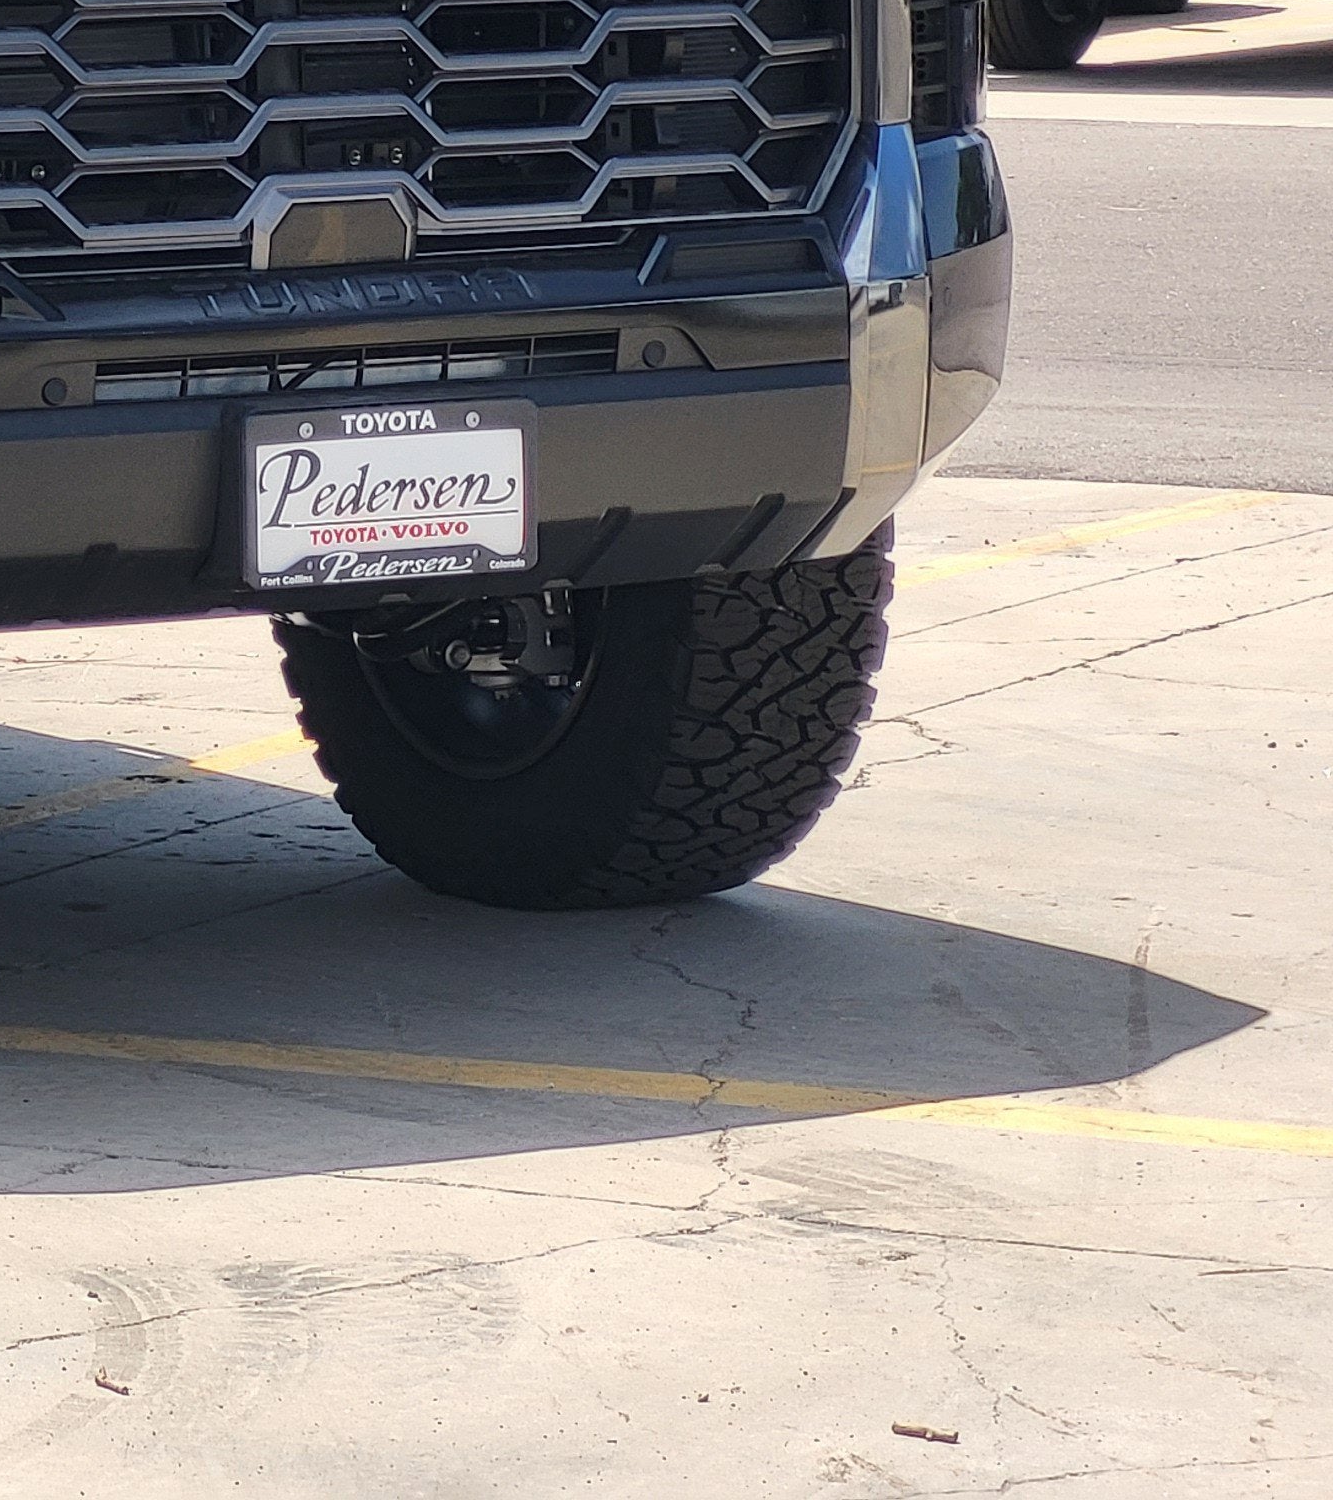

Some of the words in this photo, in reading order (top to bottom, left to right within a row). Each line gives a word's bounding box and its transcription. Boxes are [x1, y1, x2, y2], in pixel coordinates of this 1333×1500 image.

[179, 270, 535, 318] TUNDRA
[341, 409, 437, 434] TOYOTA
[259, 449, 516, 529] Pedersen
[310, 527, 379, 545] TOYOTA
[390, 521, 469, 538] VOLVO
[261, 576, 281, 587] Fort
[282, 574, 313, 585] Collins
[320, 552, 473, 583] Pedersen
[489, 558, 526, 570] Colorado
